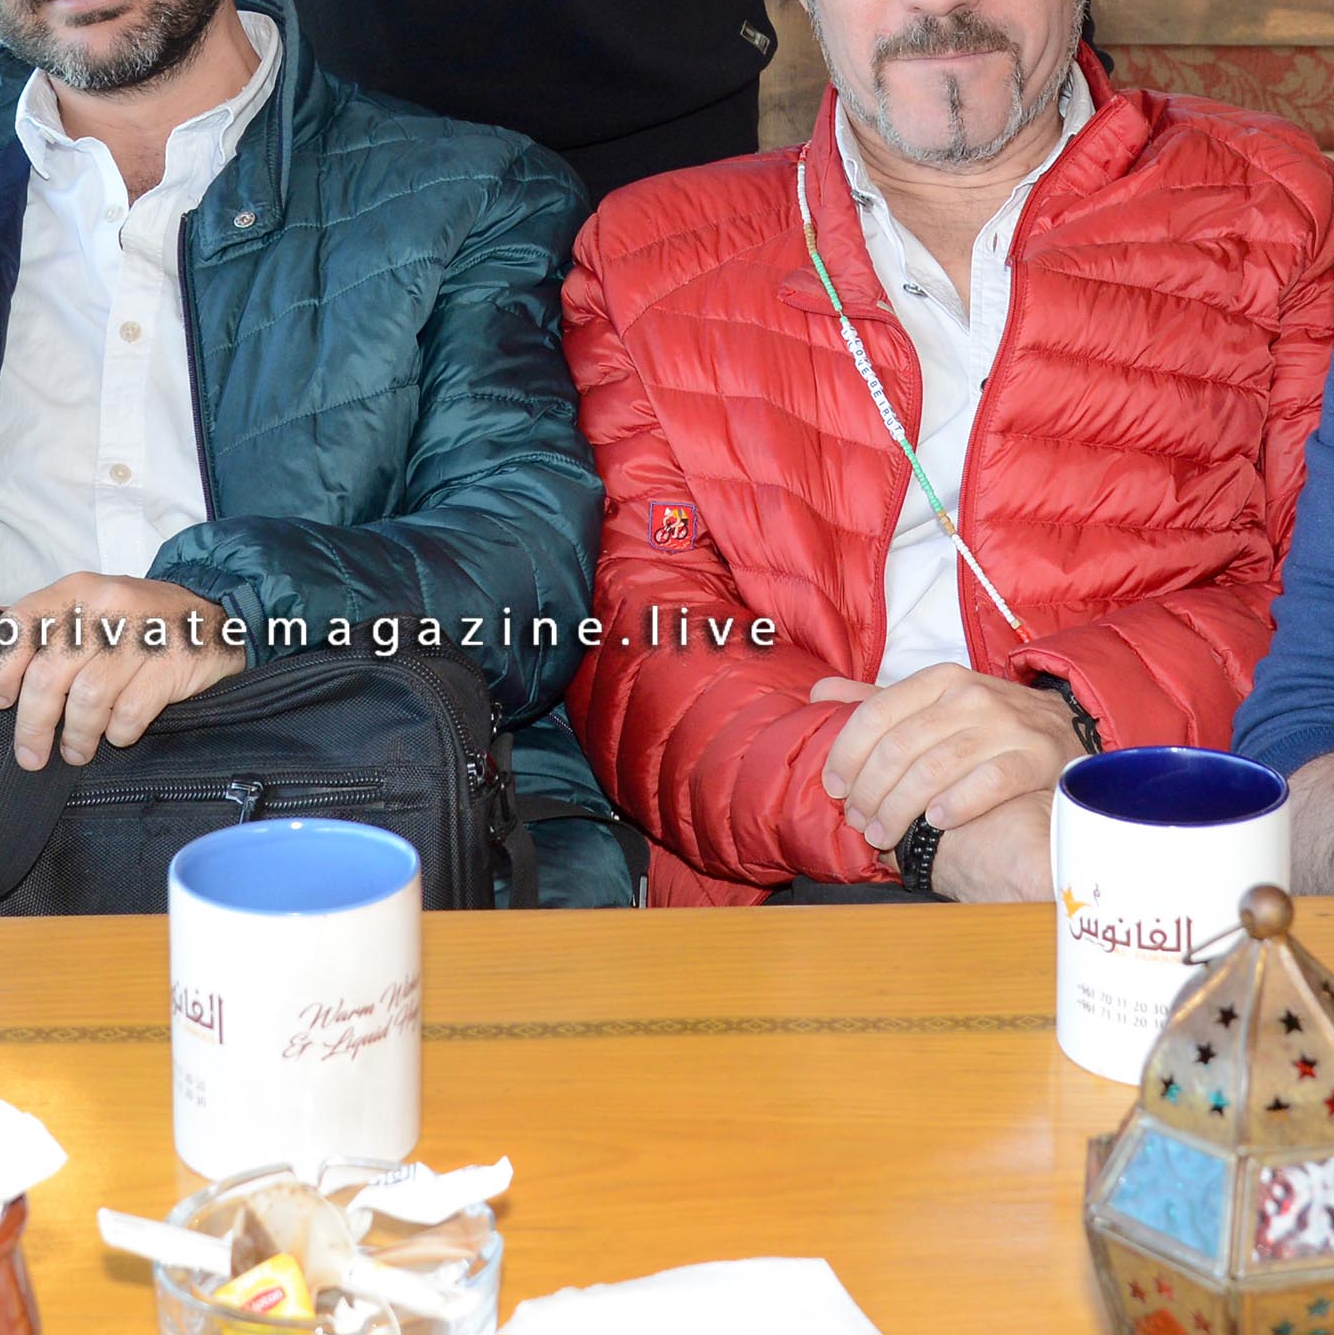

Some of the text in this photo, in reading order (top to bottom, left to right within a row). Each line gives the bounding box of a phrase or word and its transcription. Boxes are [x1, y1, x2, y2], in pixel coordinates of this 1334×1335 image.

[870, 380, 903, 433] BEIRUT
[1069, 914, 1193, 954] الفانوس
[1134, 1001, 1148, 1014] 20
[1134, 1016, 1148, 1028] 20
